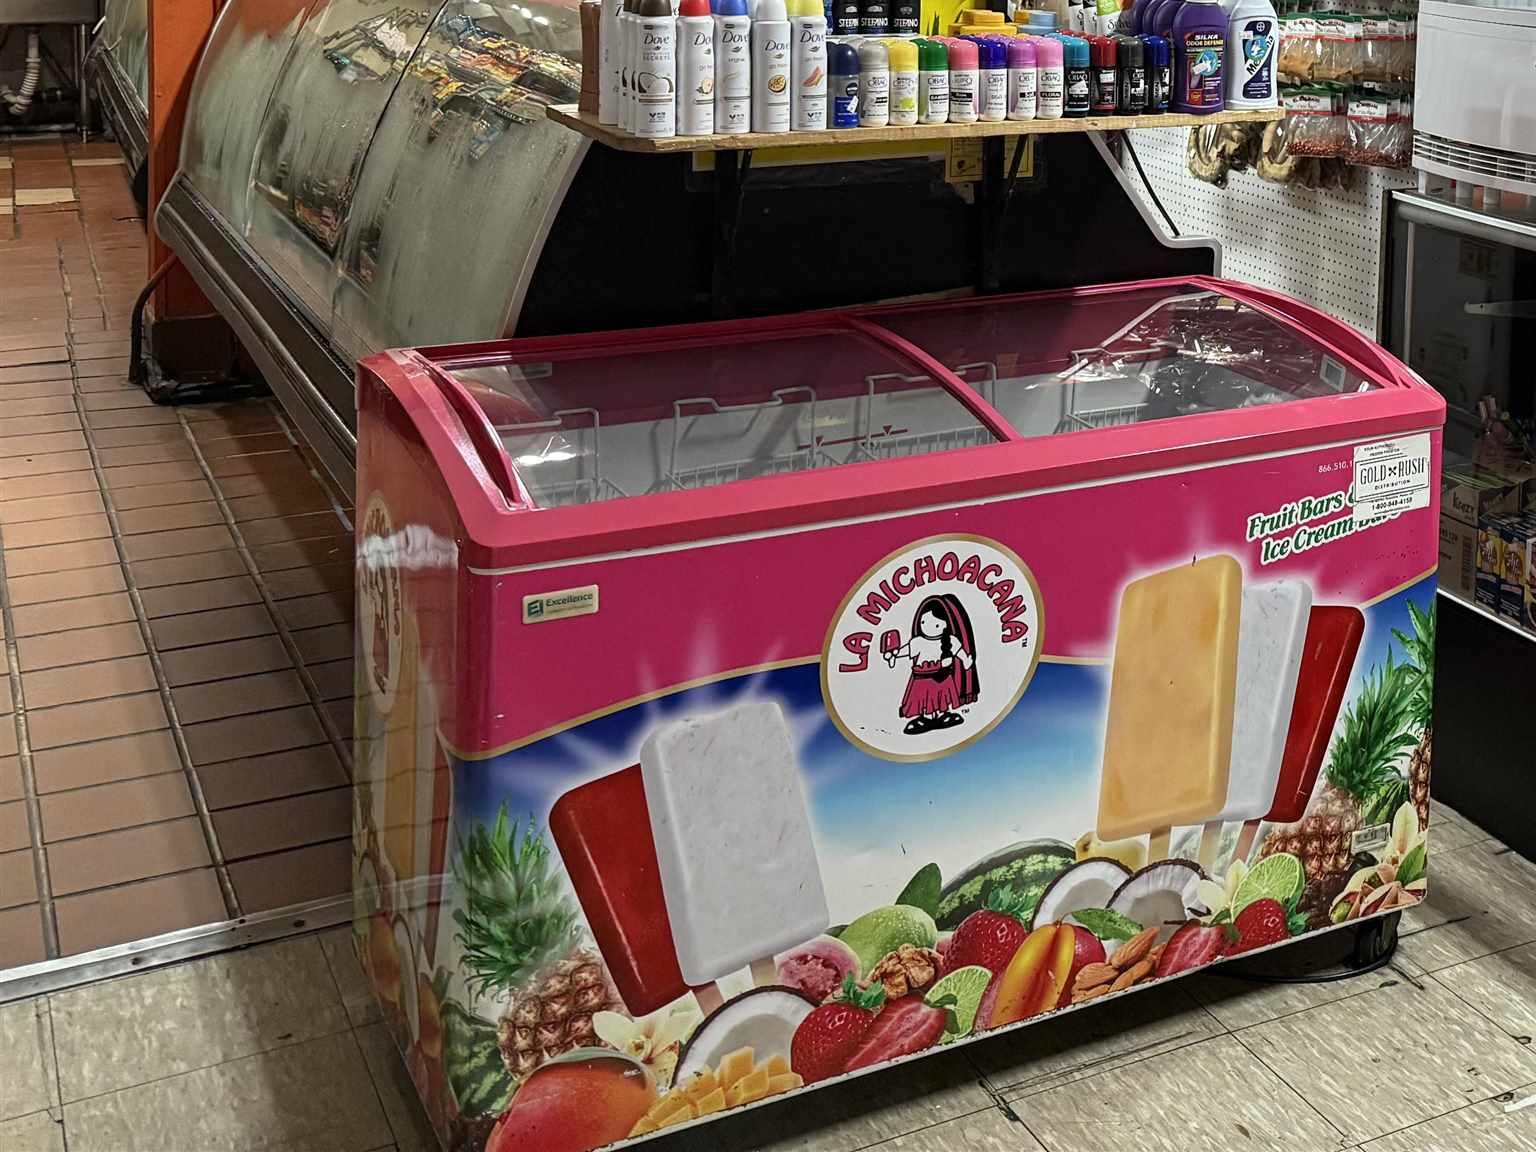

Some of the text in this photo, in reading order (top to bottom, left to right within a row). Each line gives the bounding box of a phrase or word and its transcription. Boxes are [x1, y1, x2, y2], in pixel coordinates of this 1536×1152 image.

[644, 34, 670, 45] Dove
[1360, 458, 1426, 485] GOLD RUSH
[1248, 493, 1343, 539] Fruit Bars
[1263, 516, 1355, 563] Ice Cream
[546, 592, 593, 607] Excellence
[839, 551, 1029, 673] LA MICHOACANA
